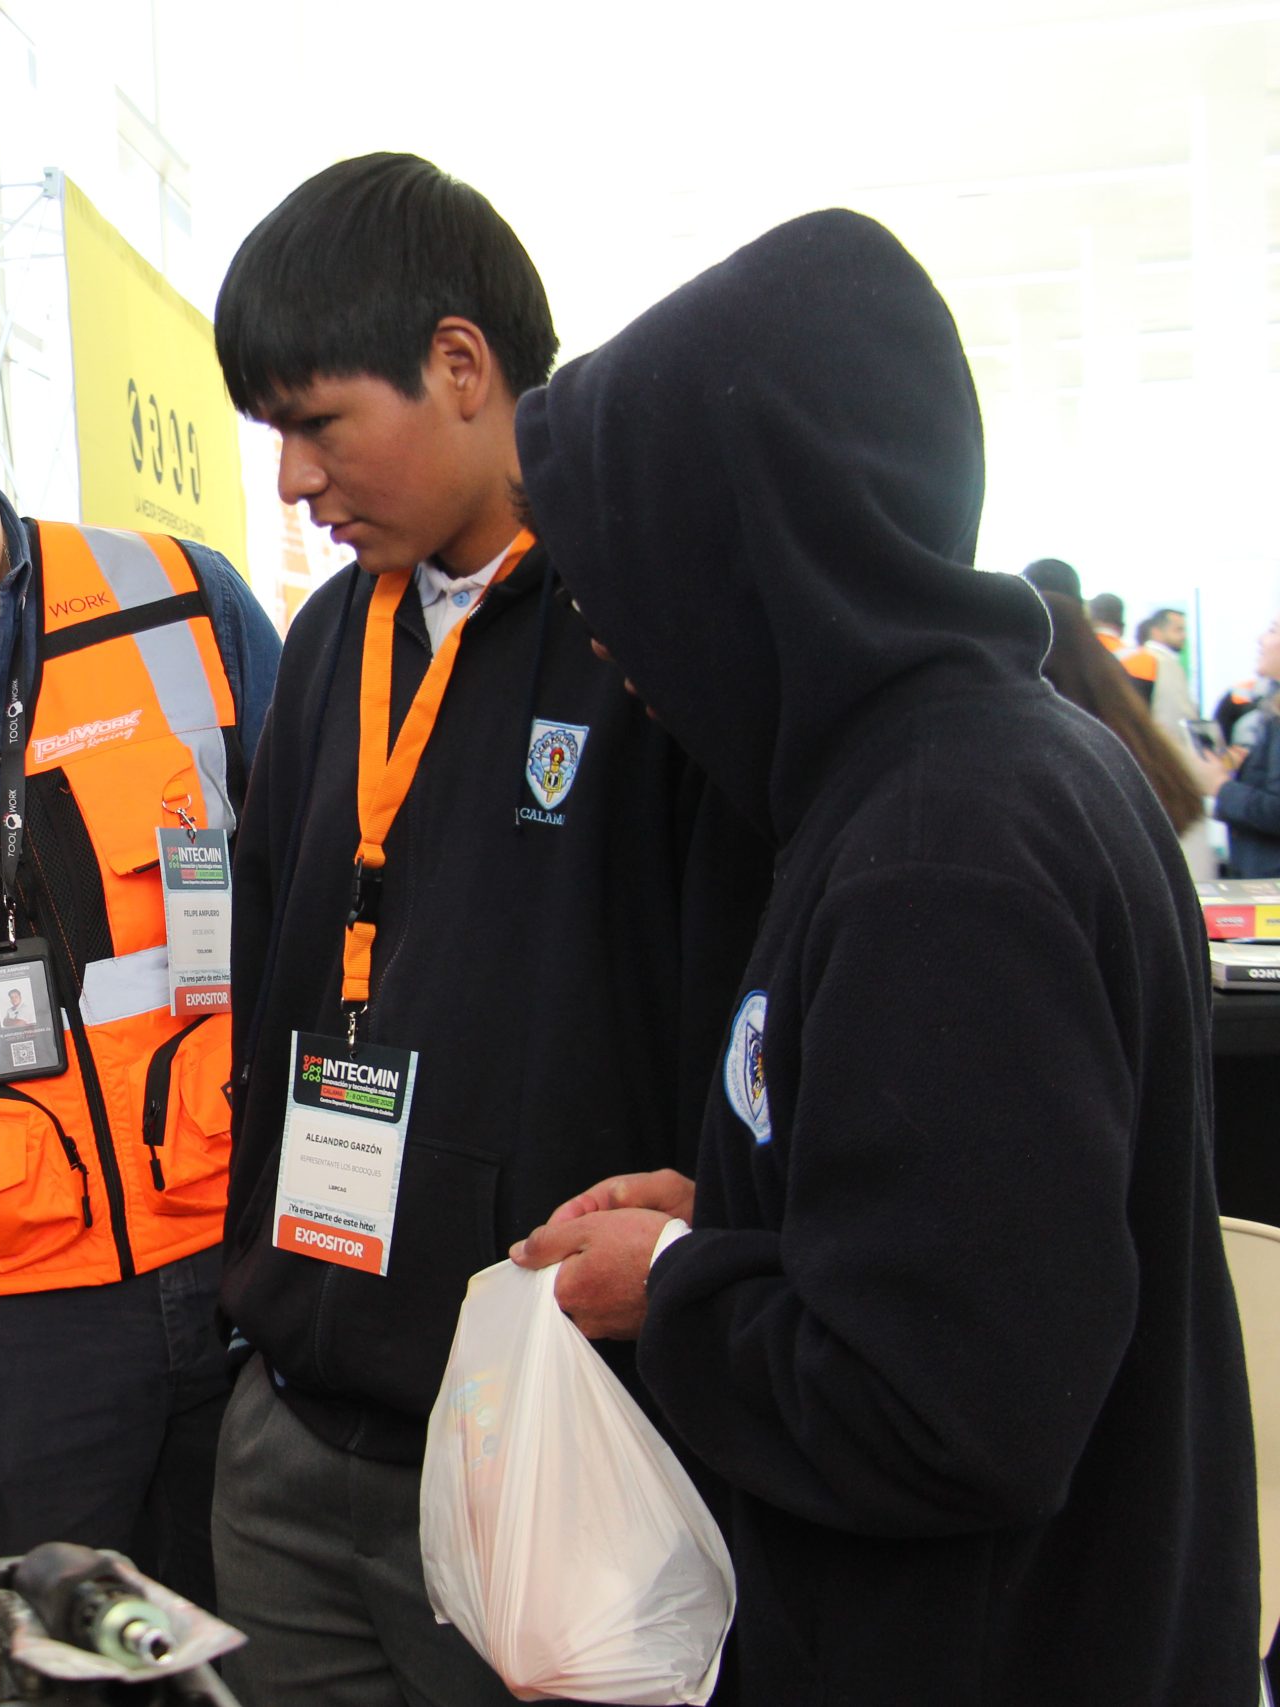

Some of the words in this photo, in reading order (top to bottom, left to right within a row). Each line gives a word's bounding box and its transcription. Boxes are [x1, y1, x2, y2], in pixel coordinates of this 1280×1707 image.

[49, 592, 111, 618] WORK
[11, 678, 19, 701] WORK
[9, 717, 19, 744] TOOL
[8, 831, 18, 857] TOOL
[178, 847, 222, 862] INTECMIN
[186, 992, 228, 1006] EXPOSITOR
[322, 1058, 399, 1090] INTECMIN
[306, 1133, 349, 1149] ALEJANDRO
[350, 1141, 382, 1155] GARZÓN
[300, 1155, 340, 1169] REPRESENTANTE
[300, 1207, 313, 1217] eres
[314, 1210, 332, 1222] parte
[333, 1215, 342, 1223] de
[343, 1218, 358, 1227] este
[359, 1220, 376, 1232] hito!
[295, 1227, 364, 1258] EXPOSITOR
